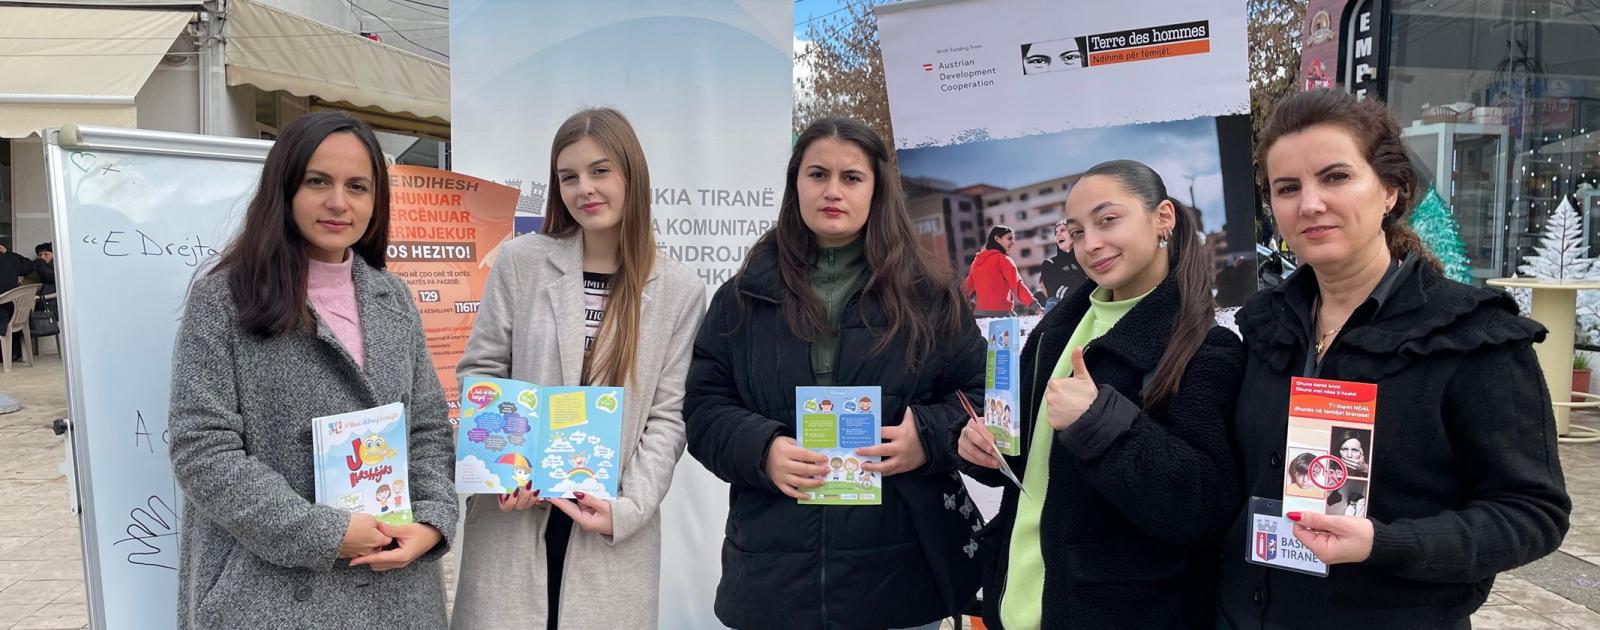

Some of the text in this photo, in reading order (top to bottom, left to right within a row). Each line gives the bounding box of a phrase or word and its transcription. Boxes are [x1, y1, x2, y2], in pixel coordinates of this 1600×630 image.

[1091, 25, 1206, 50] Terre des hommes
[938, 59, 975, 70] Austrian
[940, 67, 996, 81] Development
[941, 79, 994, 92] Cooperation
[402, 175, 478, 191] NDIHESH
[650, 187, 775, 207] KIA TIRANË
[387, 245, 470, 259] OS HEZITO!
[420, 291, 438, 302] 129
